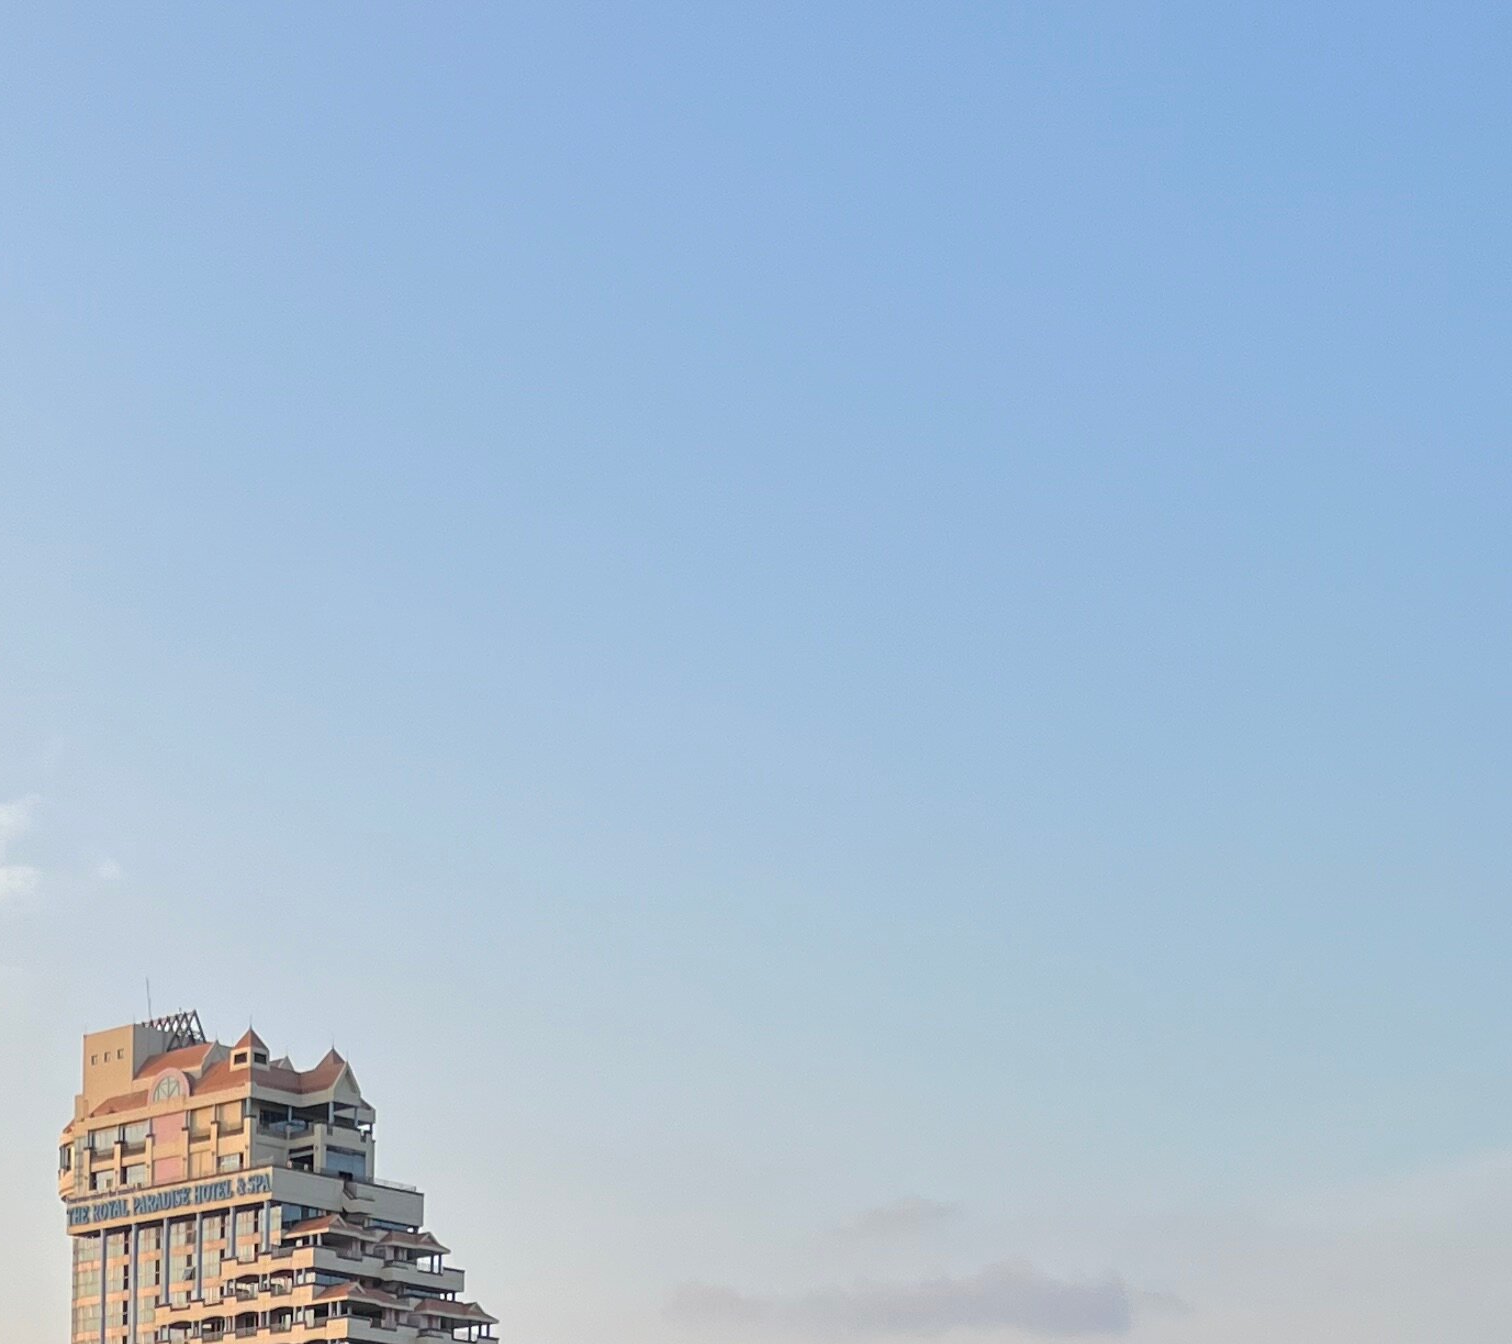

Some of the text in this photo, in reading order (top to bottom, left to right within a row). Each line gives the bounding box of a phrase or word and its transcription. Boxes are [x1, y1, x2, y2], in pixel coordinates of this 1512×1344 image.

[68, 1205, 88, 1226] THE
[92, 1199, 130, 1222] ROYAL
[133, 1190, 189, 1216] PARADISE
[194, 1179, 234, 1205] HOTEL
[248, 1173, 272, 1195] SPA
